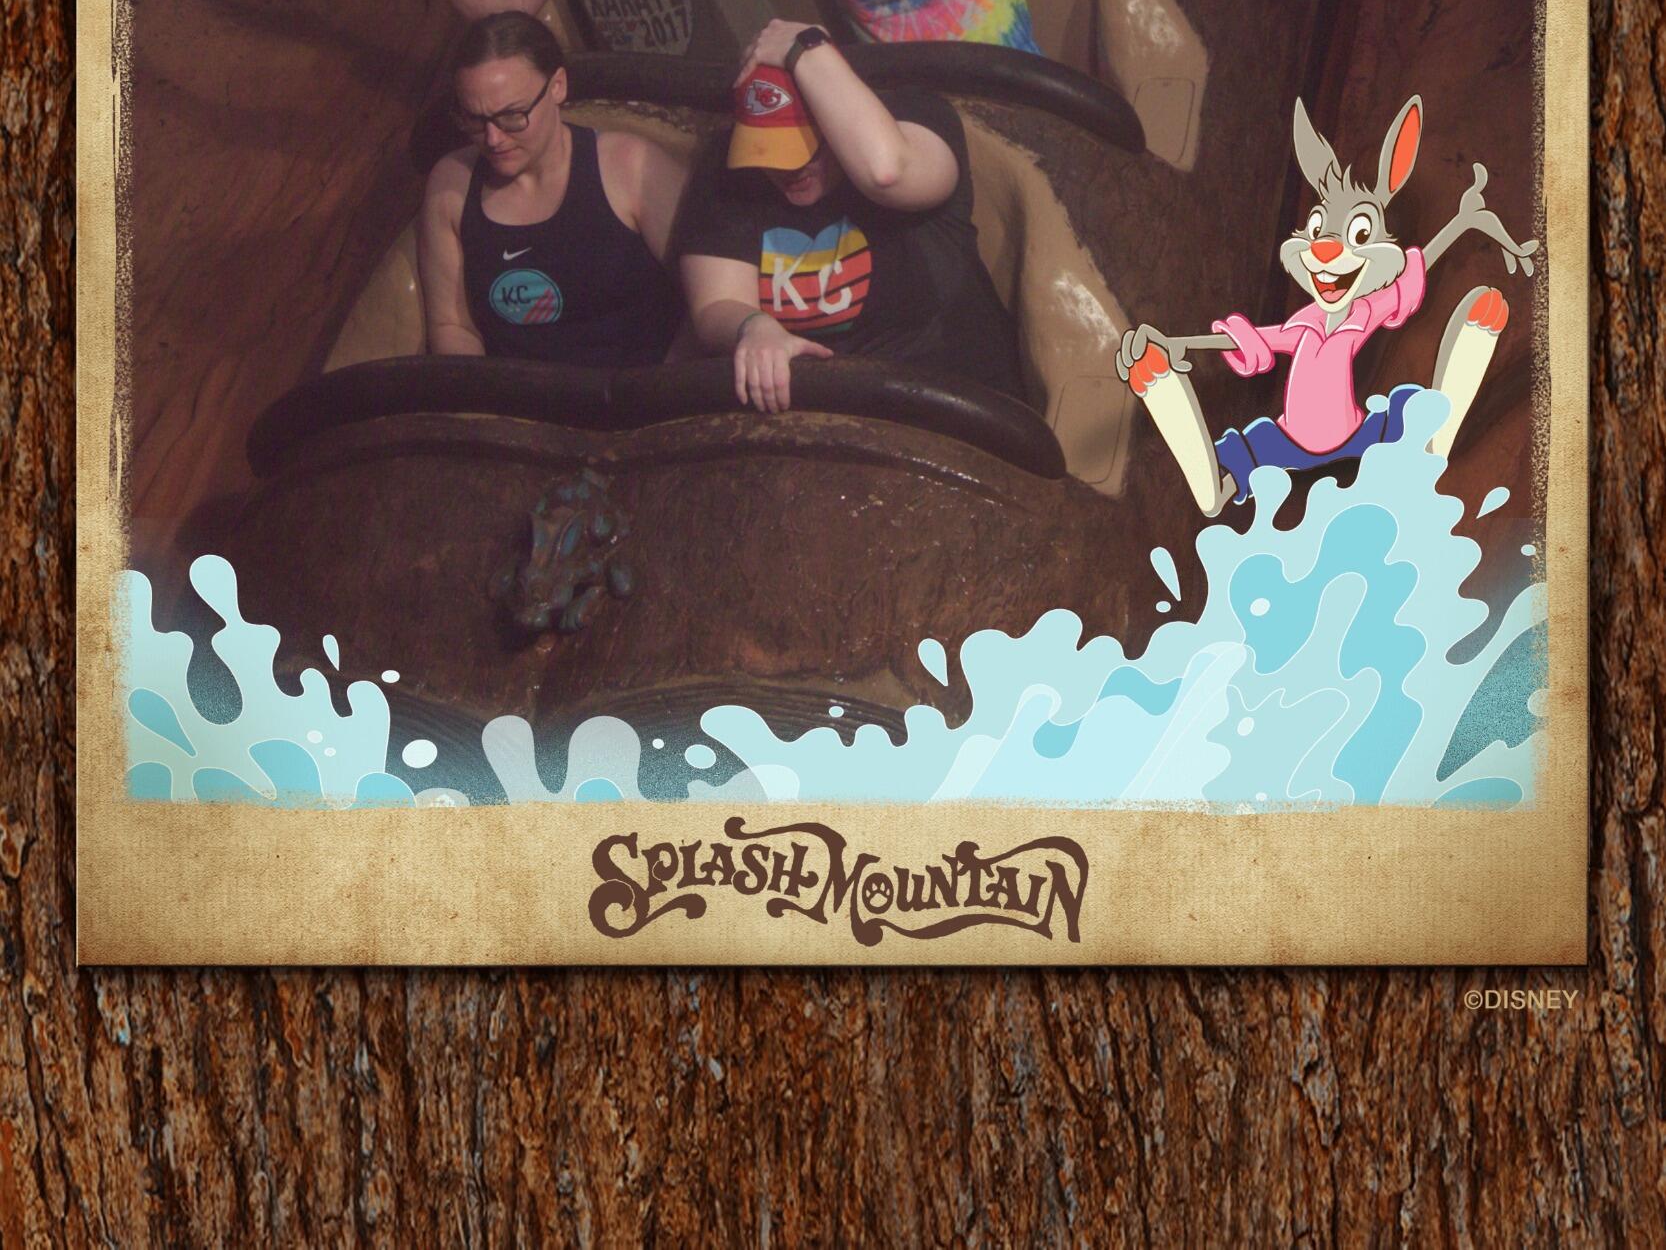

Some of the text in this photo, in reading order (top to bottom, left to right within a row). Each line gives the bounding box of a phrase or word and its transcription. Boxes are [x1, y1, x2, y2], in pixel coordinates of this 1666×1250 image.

[640, 6, 689, 47] 2017
[502, 285, 532, 306] KC
[771, 252, 852, 315] KC
